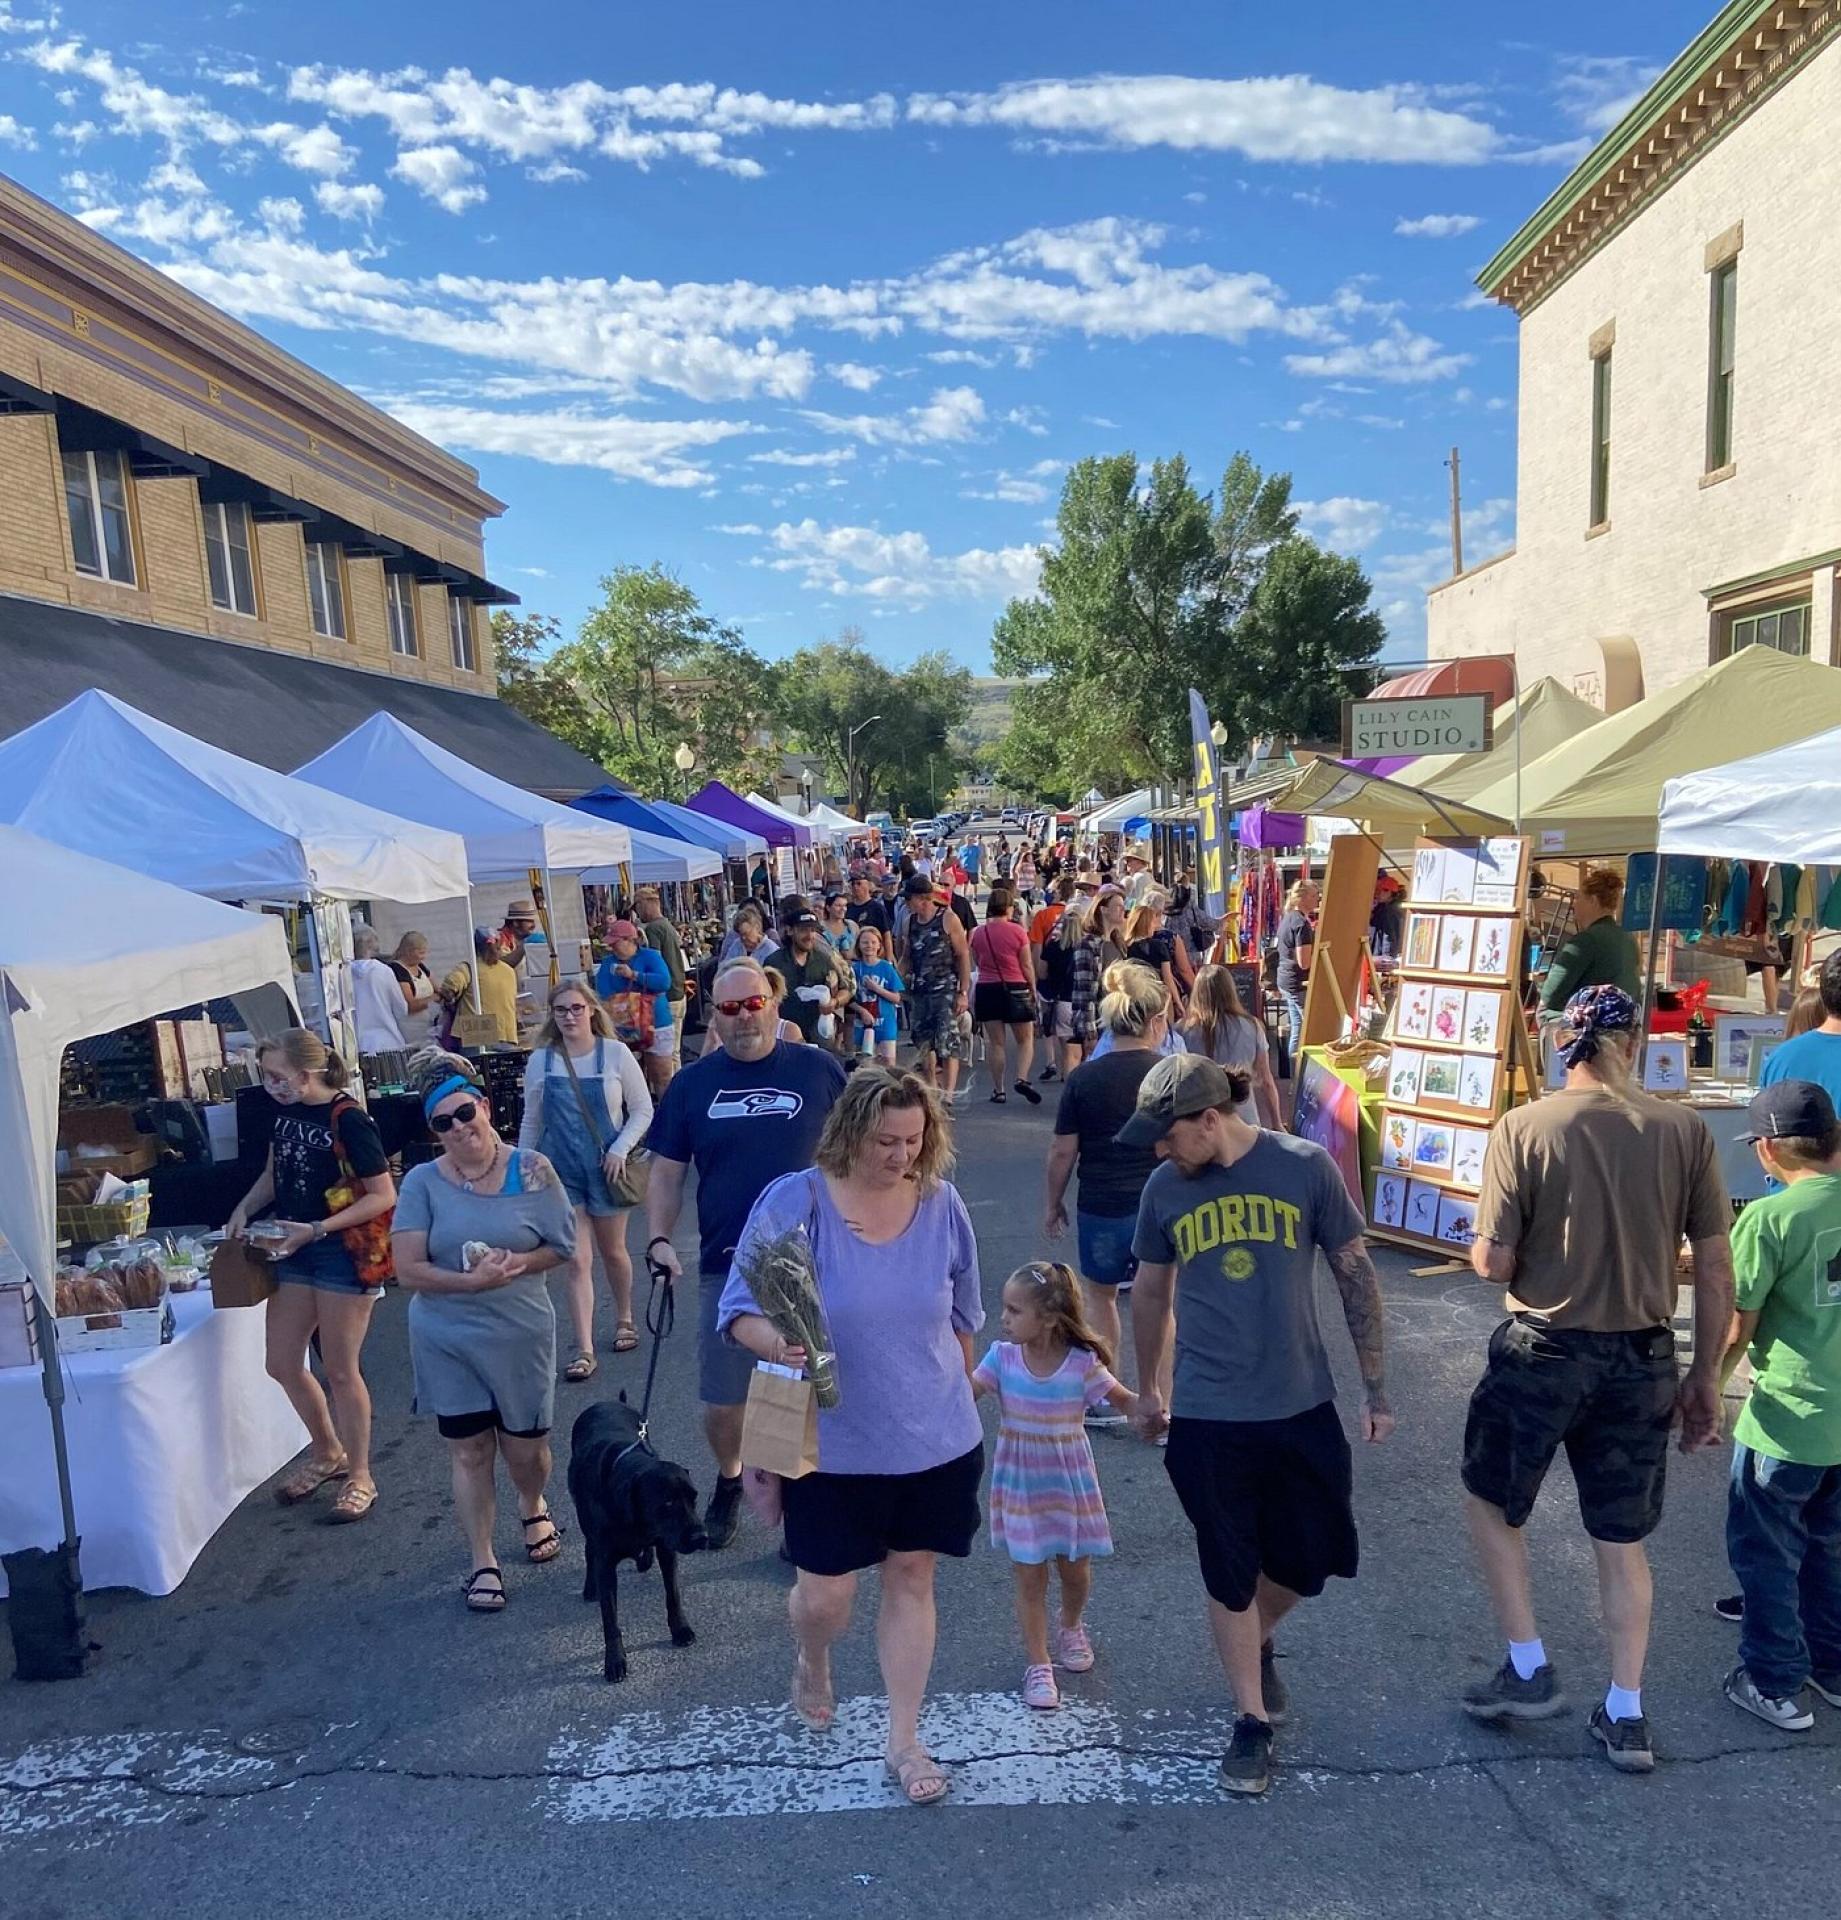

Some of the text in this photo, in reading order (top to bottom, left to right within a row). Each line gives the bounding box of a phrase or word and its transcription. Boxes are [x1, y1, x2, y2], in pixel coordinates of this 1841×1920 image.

[1358, 726, 1462, 750] STUDIO
[1359, 708, 1452, 725] LILY CAIN
[1197, 742, 1222, 893] ATM
[1173, 1194, 1301, 1264] DORDT
